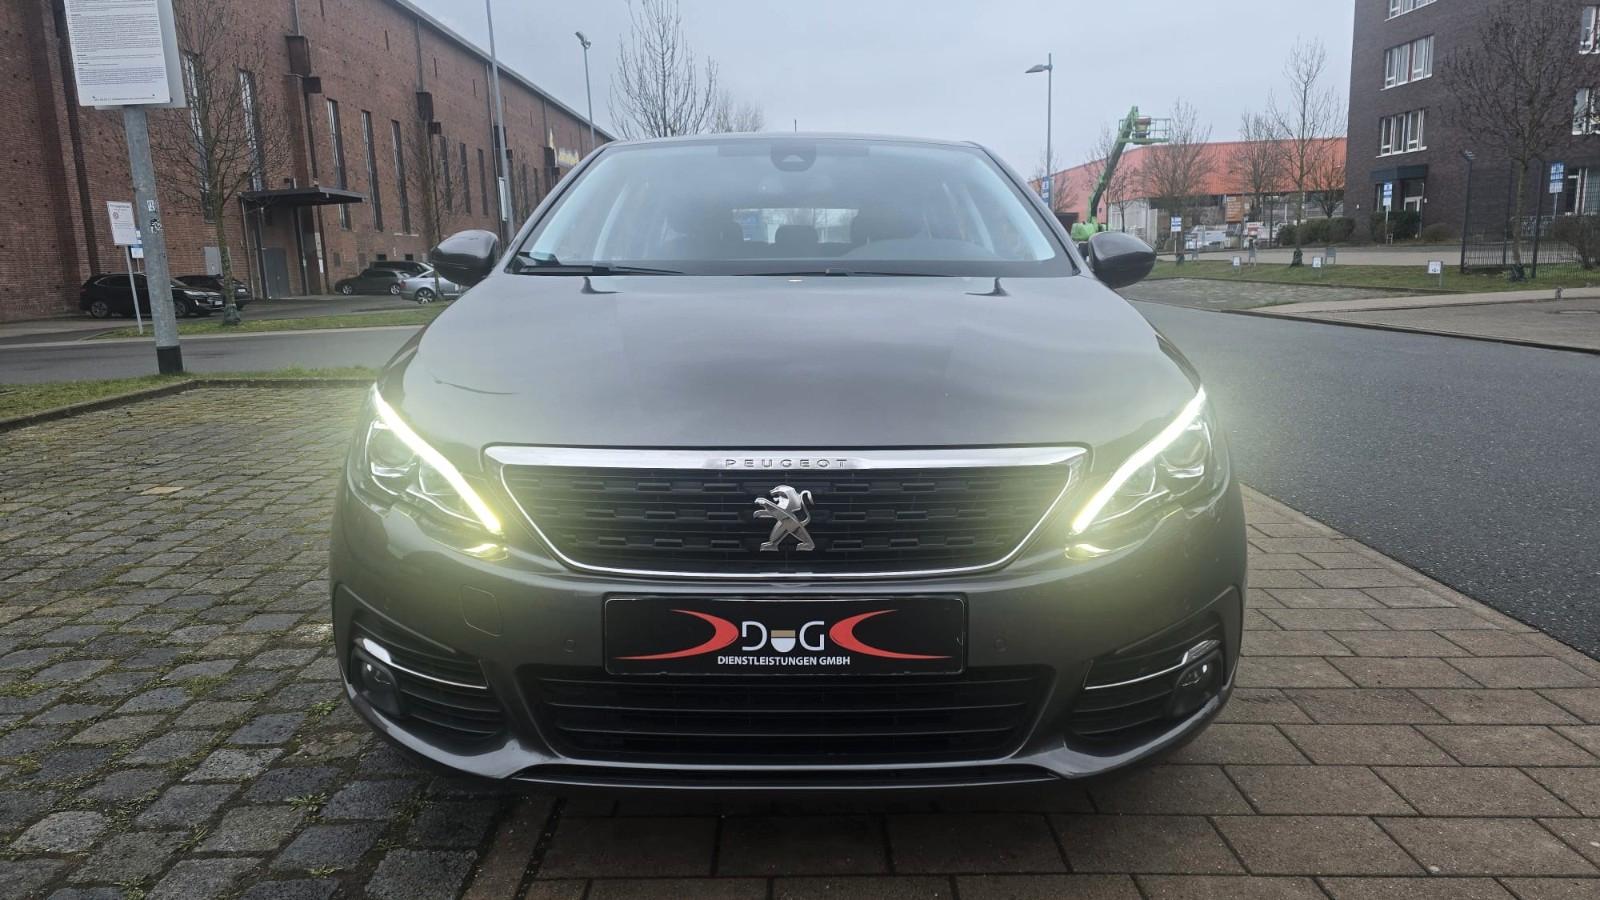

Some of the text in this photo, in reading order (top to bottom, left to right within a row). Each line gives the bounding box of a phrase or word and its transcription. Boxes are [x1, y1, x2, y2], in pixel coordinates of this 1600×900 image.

[725, 458, 848, 468] PEUGEOT
[717, 656, 851, 666] DIENSTLEISTUNGEN GMBH
